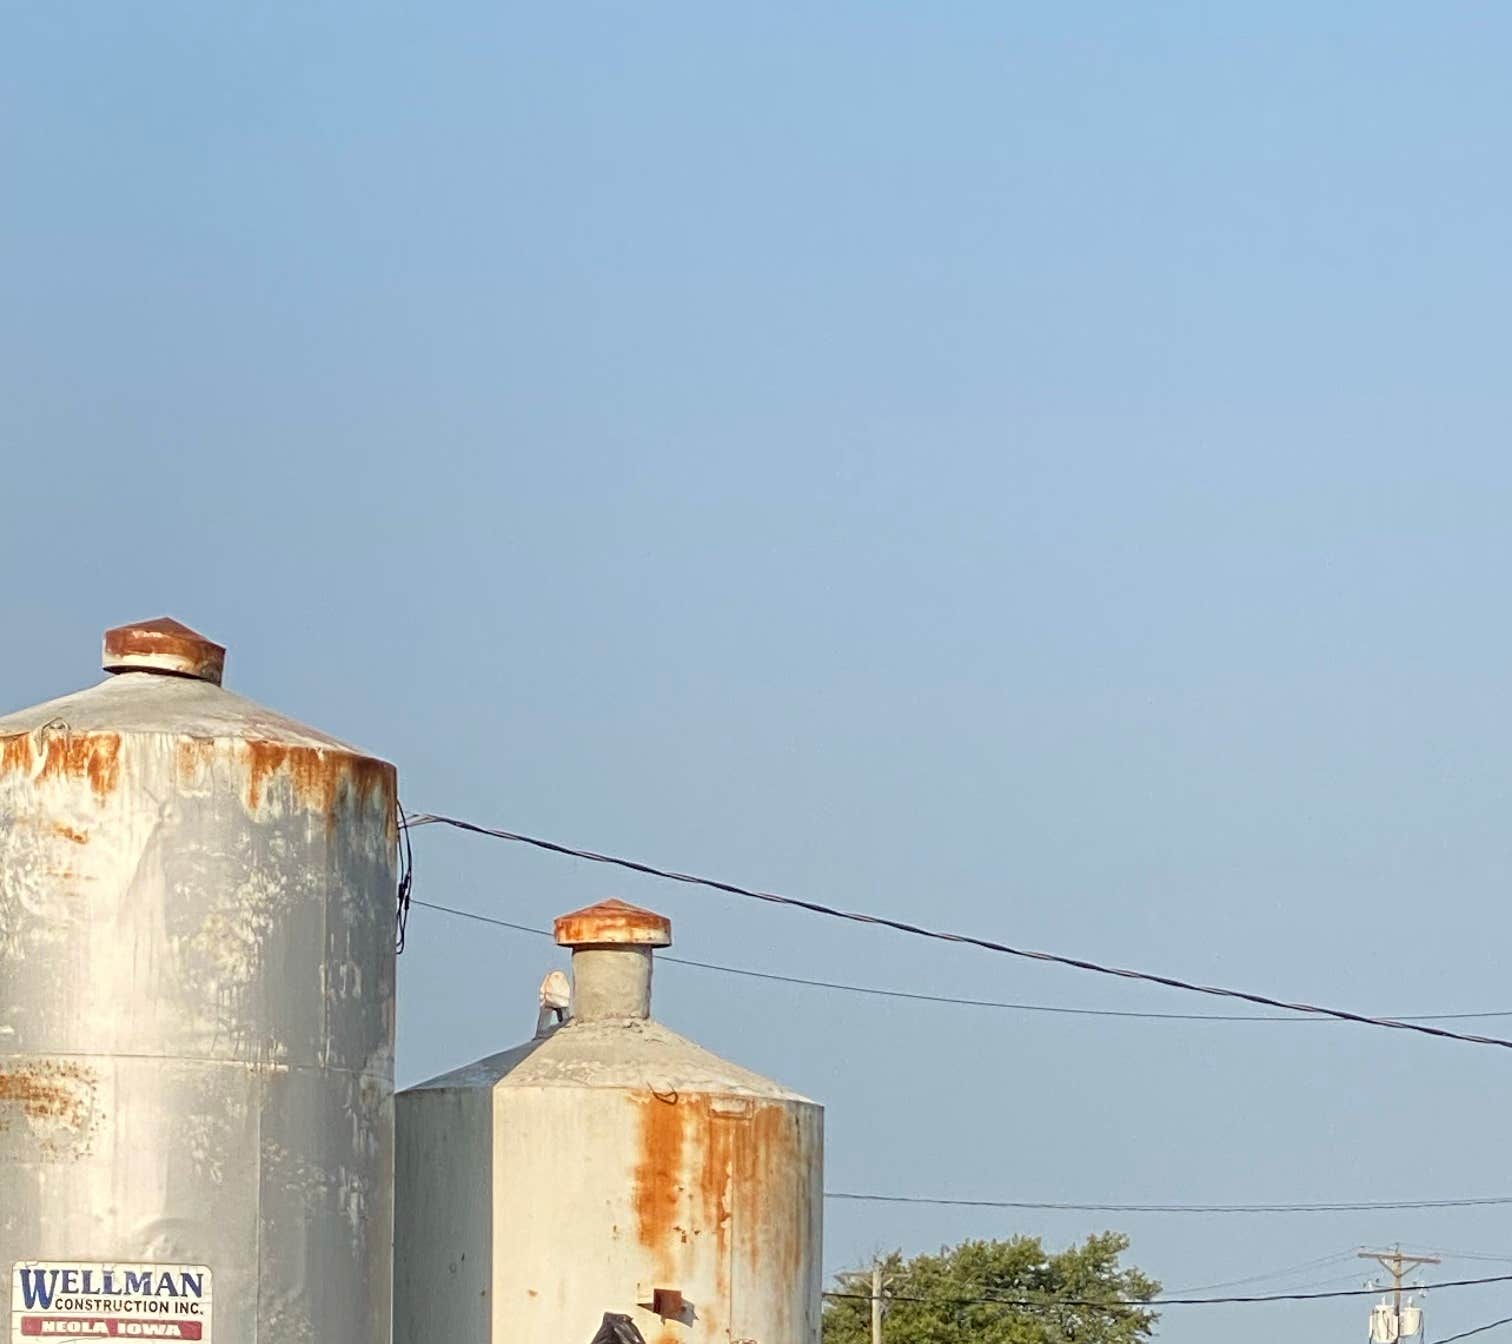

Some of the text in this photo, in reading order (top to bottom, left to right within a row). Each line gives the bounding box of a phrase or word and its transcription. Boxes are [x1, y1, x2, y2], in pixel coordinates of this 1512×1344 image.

[20, 1269, 204, 1310] WELLMAN
[55, 1298, 204, 1315] CONSTRUCTION INC.
[40, 1320, 182, 1336] NEOLA IOWA
